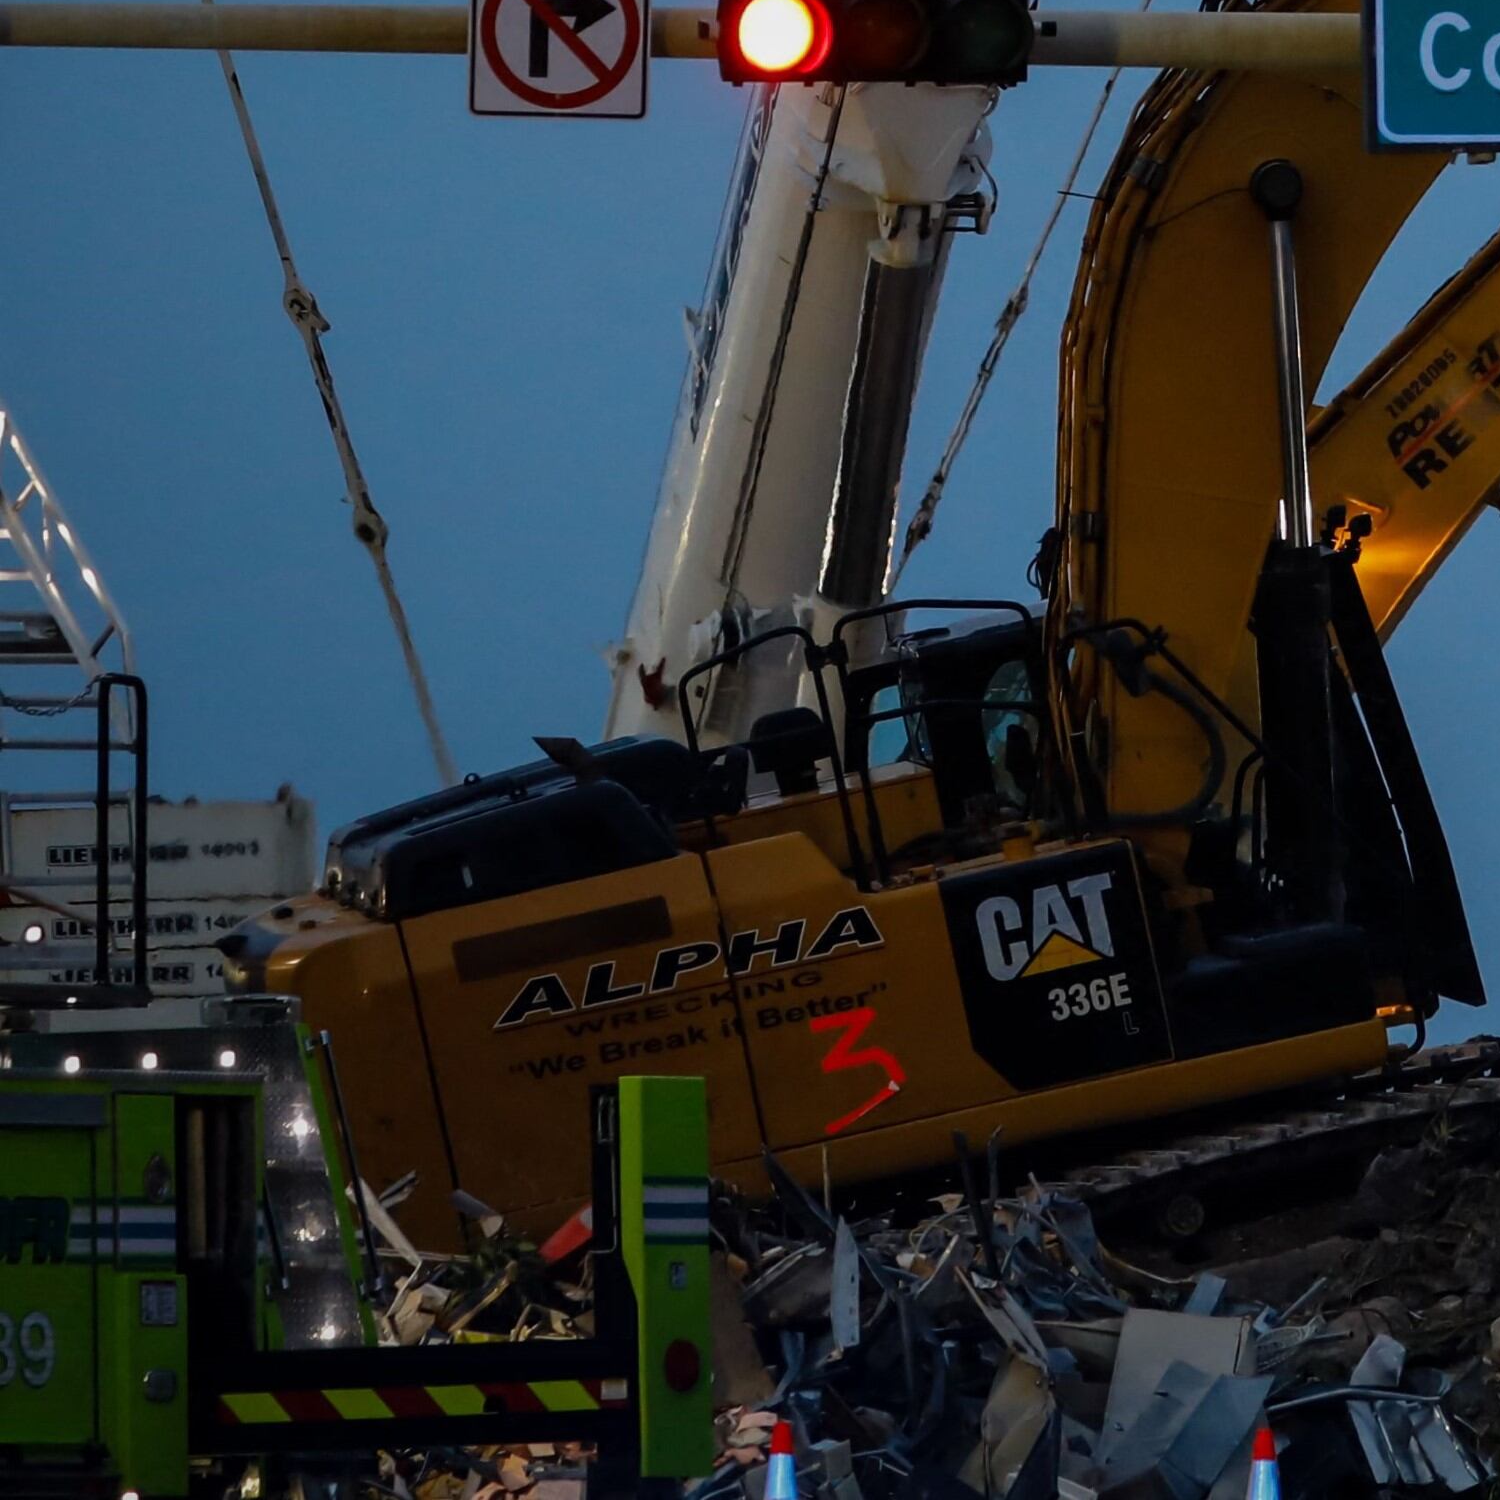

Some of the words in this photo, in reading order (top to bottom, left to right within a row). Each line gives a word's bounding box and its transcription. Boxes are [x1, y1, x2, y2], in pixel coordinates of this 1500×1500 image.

[493, 905, 886, 1029] ALPHA
[975, 872, 1116, 981] CAT
[564, 970, 823, 1038] WRECKING
[1047, 972, 1133, 1022] 336E
[600, 1023, 709, 1066] Break
[809, 1006, 907, 1136] 3
